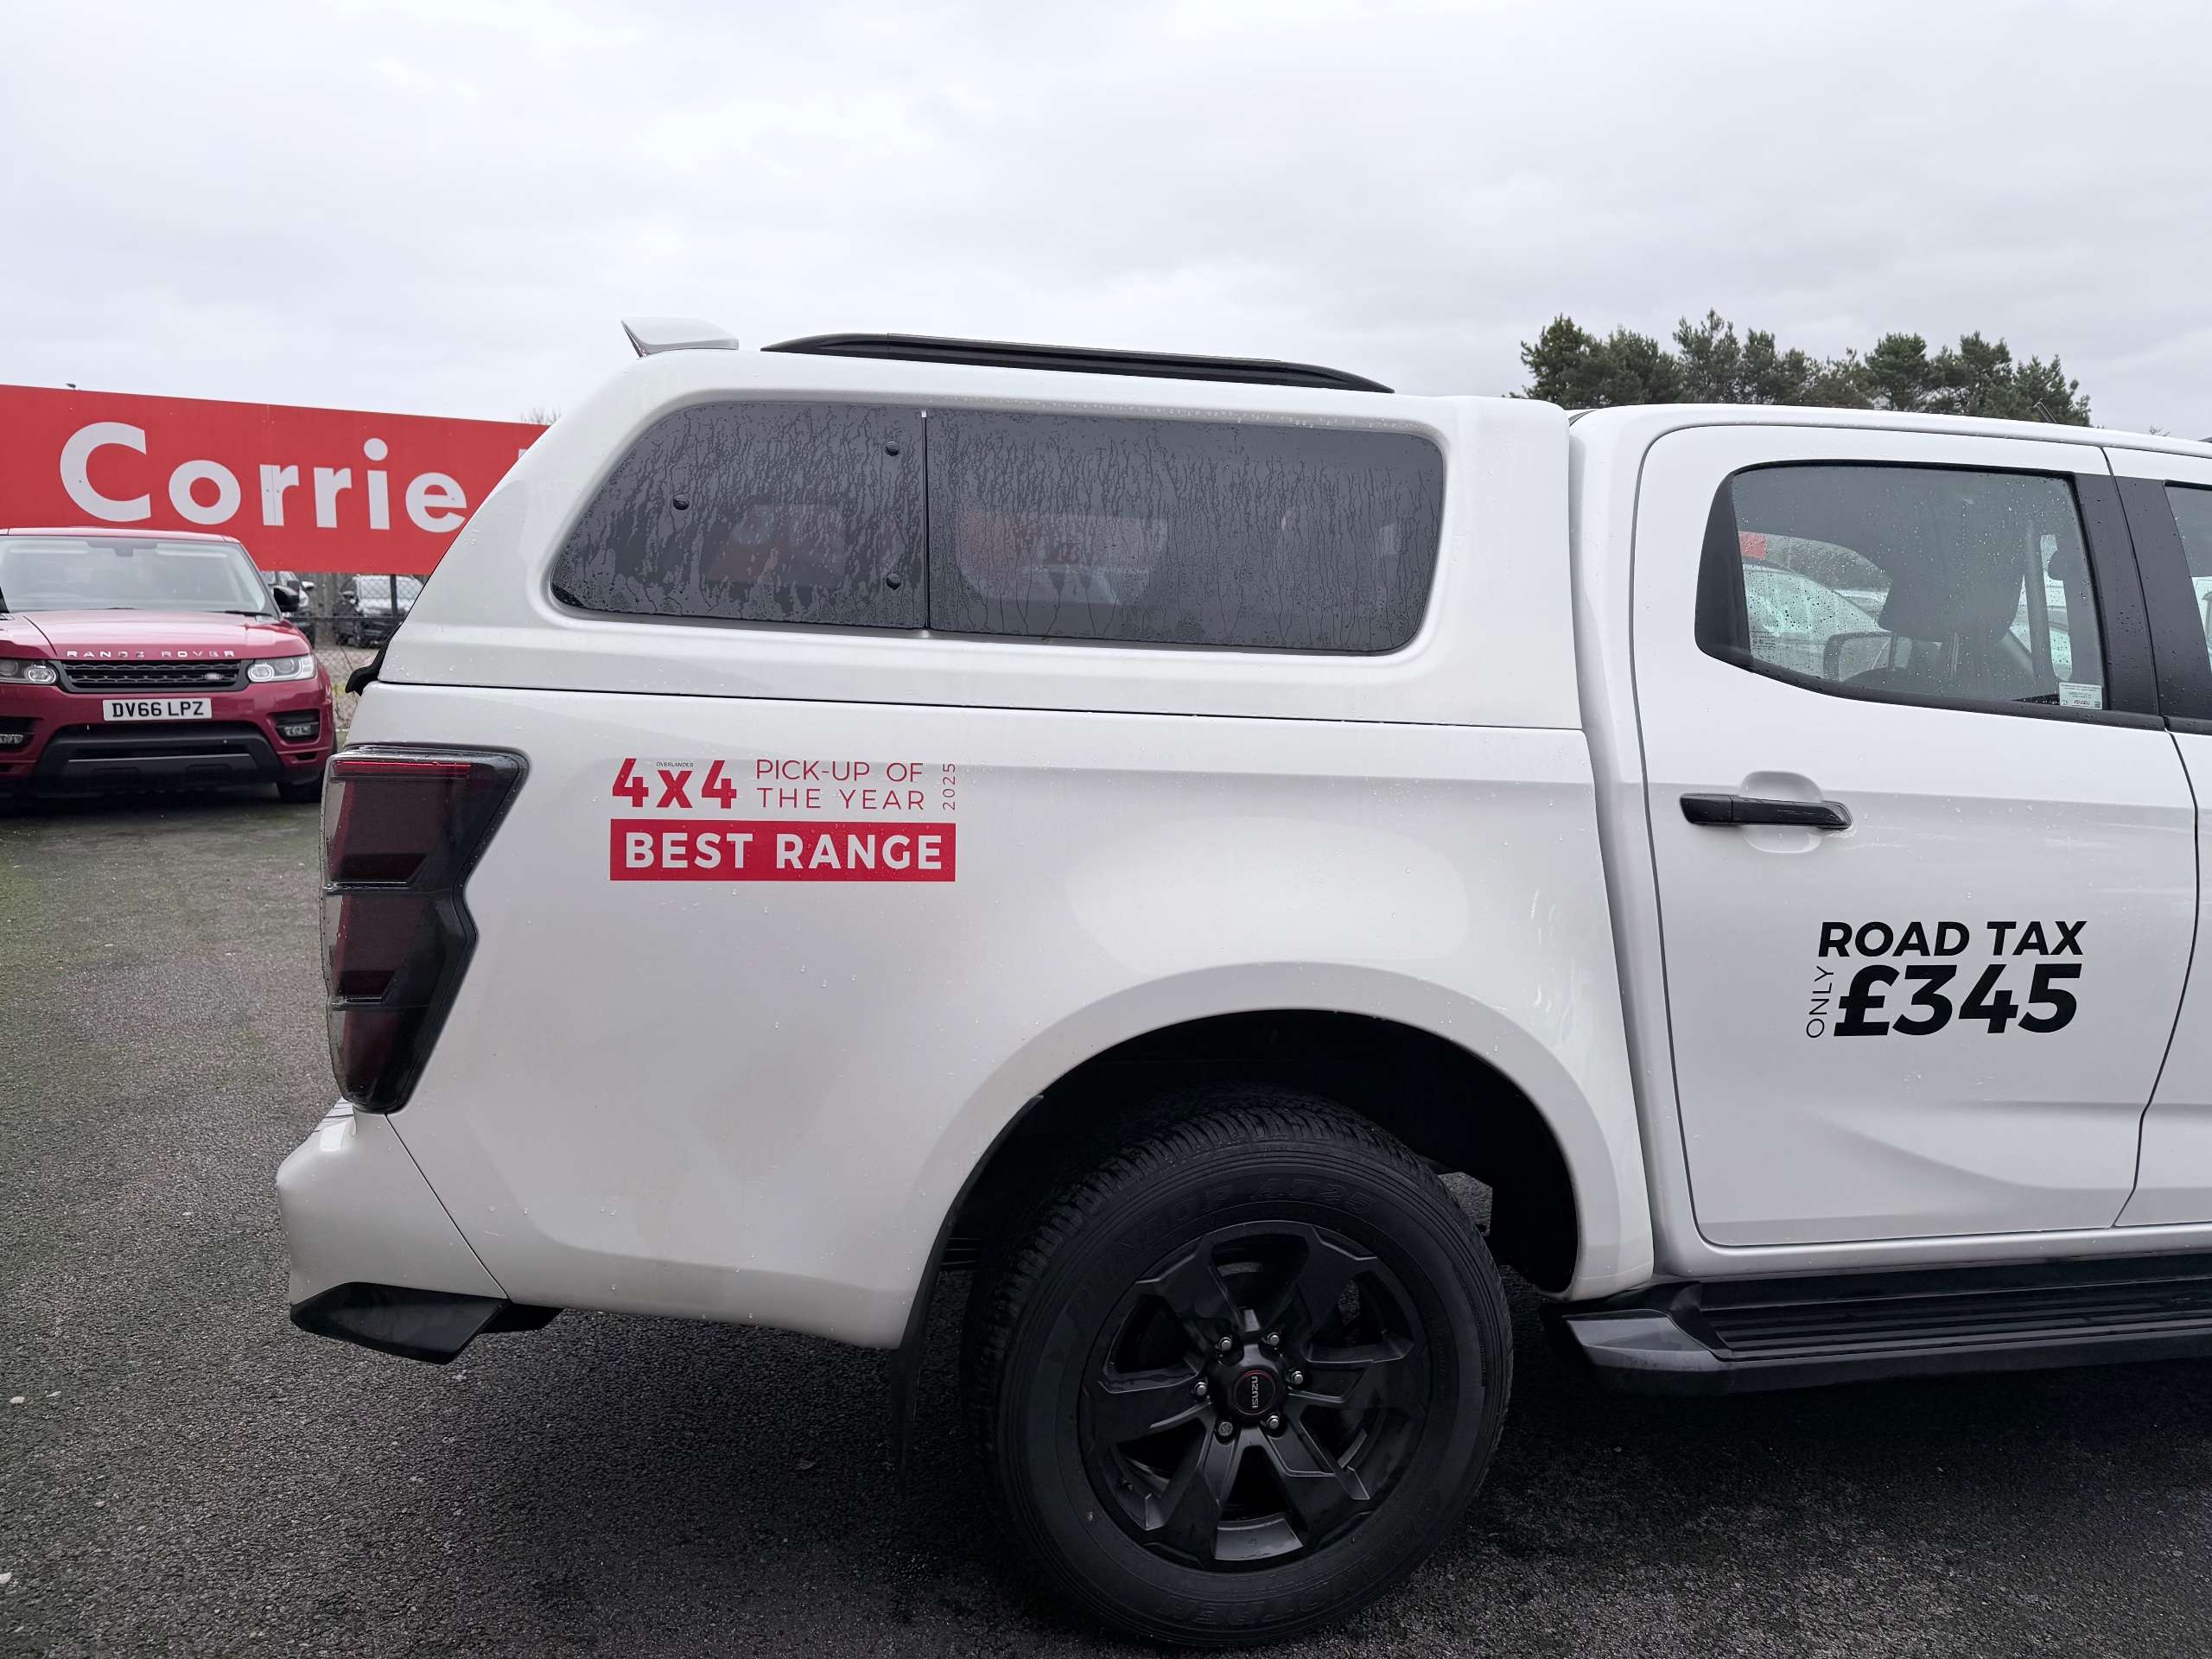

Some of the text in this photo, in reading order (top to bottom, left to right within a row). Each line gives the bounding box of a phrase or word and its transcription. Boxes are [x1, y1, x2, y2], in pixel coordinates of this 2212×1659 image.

[60, 422, 467, 533] Corrie
[111, 701, 204, 717] DV66 LPZ
[755, 759, 924, 783] PICK-UP OF
[942, 762, 957, 810] 2025
[756, 787, 925, 810] THE YEAR
[625, 831, 943, 871] BEST RANGE
[1817, 920, 2088, 957] ROAD TAX
[1806, 965, 1834, 1039] ONLY
[1833, 963, 2082, 1038] £345
[1250, 1376, 1259, 1409] ISUZU
